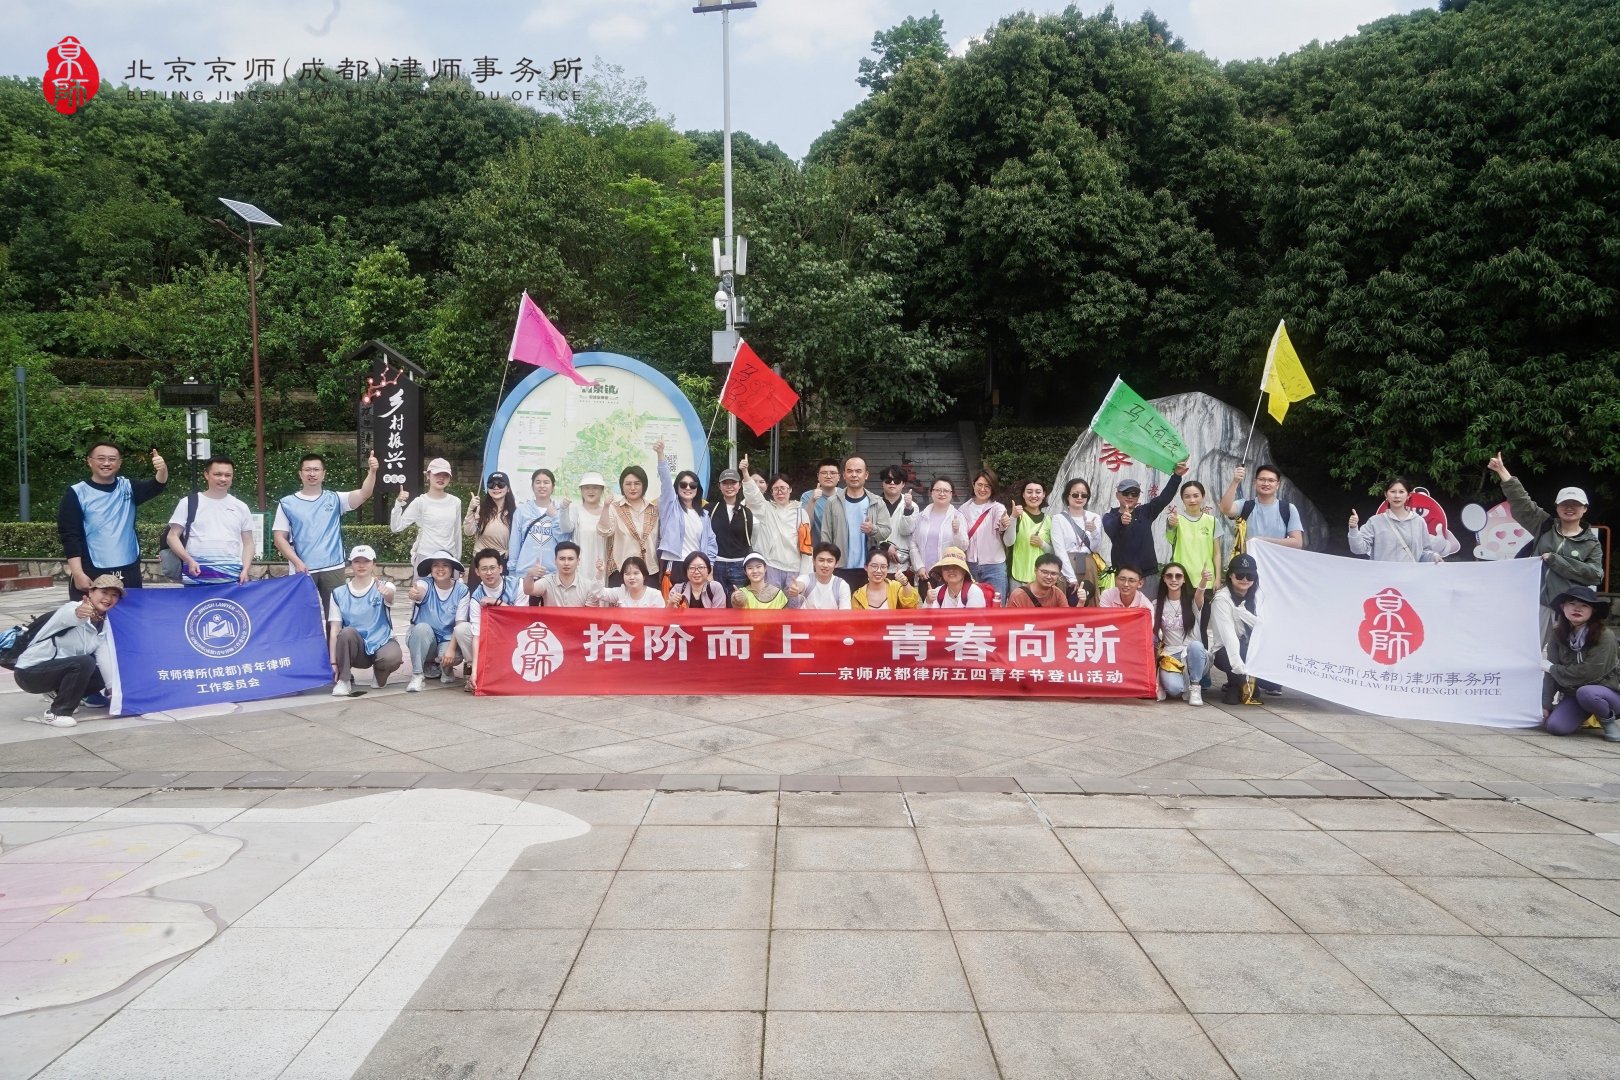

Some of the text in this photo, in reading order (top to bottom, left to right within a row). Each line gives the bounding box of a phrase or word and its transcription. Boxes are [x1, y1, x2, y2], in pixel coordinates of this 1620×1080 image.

[378, 388, 406, 469] 乡村振兴
[157, 657, 292, 681] 京师律所(成都)青年律师
[1287, 654, 1502, 687] 北京京师(成都)律师事务所
[197, 677, 261, 694] 工作委员会
[1360, 680, 1383, 690] LAW
[1411, 687, 1462, 696] CHENGDU
[1465, 688, 1502, 696] OFFICE
